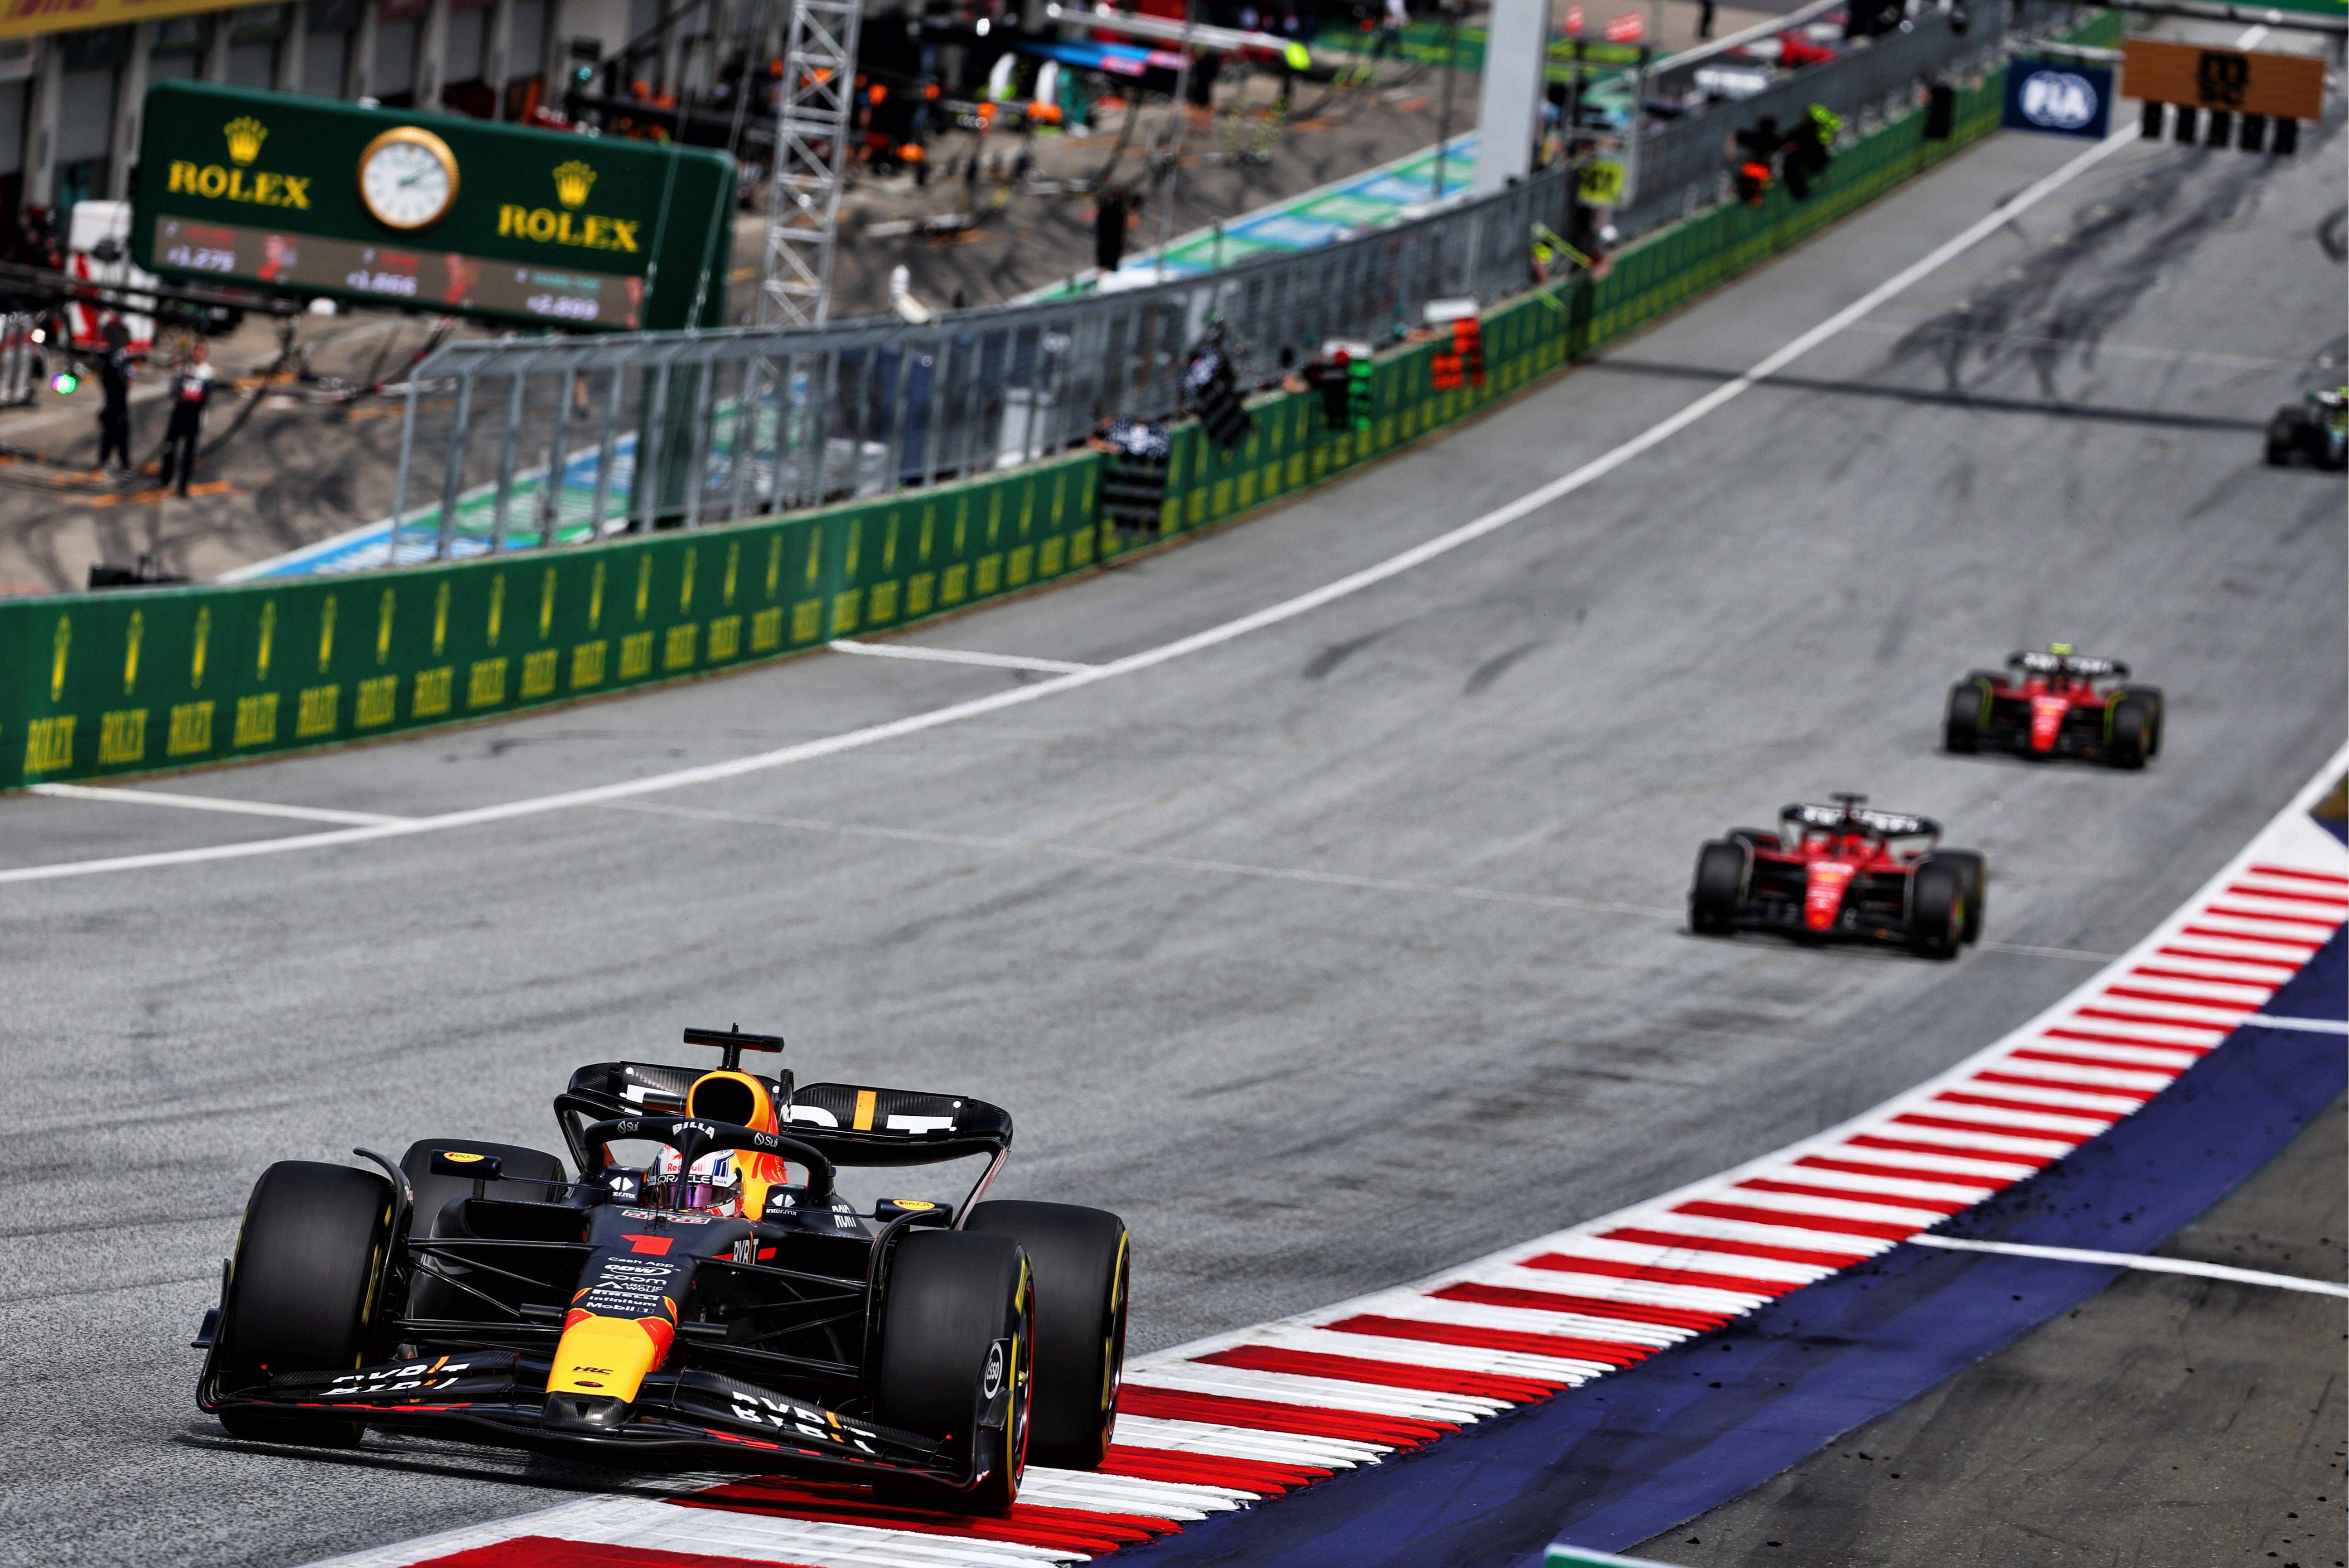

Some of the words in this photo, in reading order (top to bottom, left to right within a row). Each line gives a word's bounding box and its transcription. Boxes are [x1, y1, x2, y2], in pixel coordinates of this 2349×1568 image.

[2024, 77, 2086, 121] FIA
[168, 159, 310, 210] ROLEX
[497, 204, 640, 252] ROLEX
[627, 1121, 638, 1132] Sui
[672, 1121, 715, 1140] BILLA
[764, 1137, 778, 1148] Sui
[689, 1163, 702, 1172] ull
[620, 1234, 674, 1256] 1
[604, 1264, 657, 1274] CDW
[600, 1273, 667, 1285] zoom
[586, 1302, 635, 1312] Mobil
[573, 1366, 614, 1375] HRC
